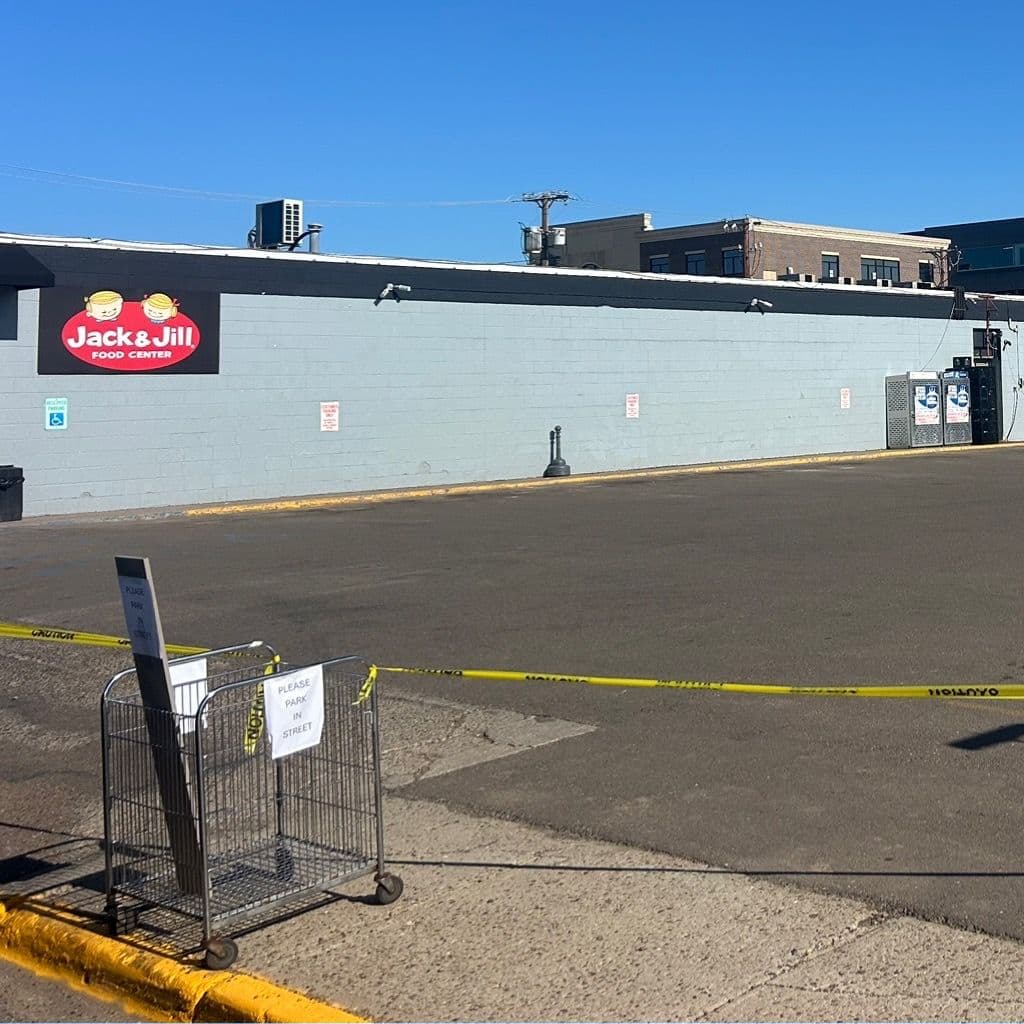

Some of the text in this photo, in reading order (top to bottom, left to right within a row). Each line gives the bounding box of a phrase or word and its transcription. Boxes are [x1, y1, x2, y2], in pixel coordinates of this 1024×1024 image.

[67, 326, 193, 348] Jack & Jill
[91, 351, 172, 359] FOOD CENTER
[278, 679, 311, 694] PLEASE
[285, 696, 307, 708] PARK
[293, 712, 302, 720] IN
[282, 722, 312, 739] STREET
